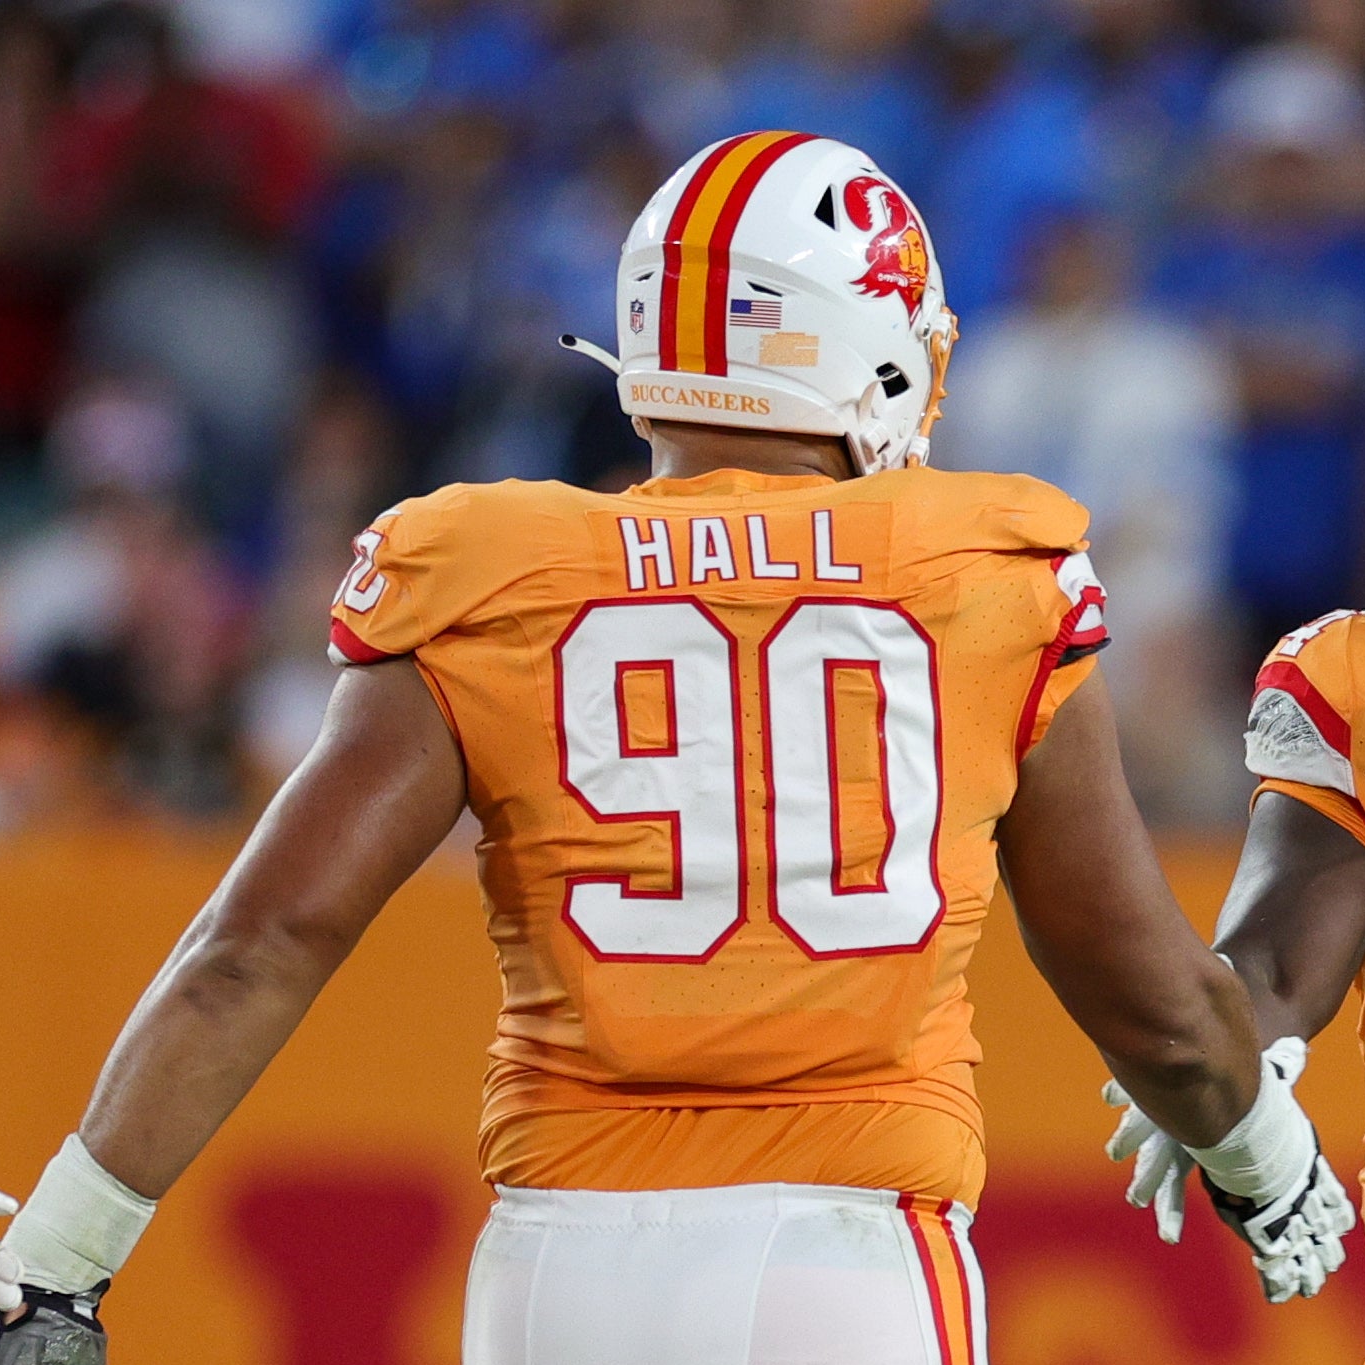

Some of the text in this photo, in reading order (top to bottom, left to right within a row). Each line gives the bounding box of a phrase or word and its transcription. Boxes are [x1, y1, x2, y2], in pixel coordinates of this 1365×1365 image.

[630, 384, 771, 416] BUCCANEERS
[616, 510, 862, 591] HALL
[552, 595, 947, 964] 90
